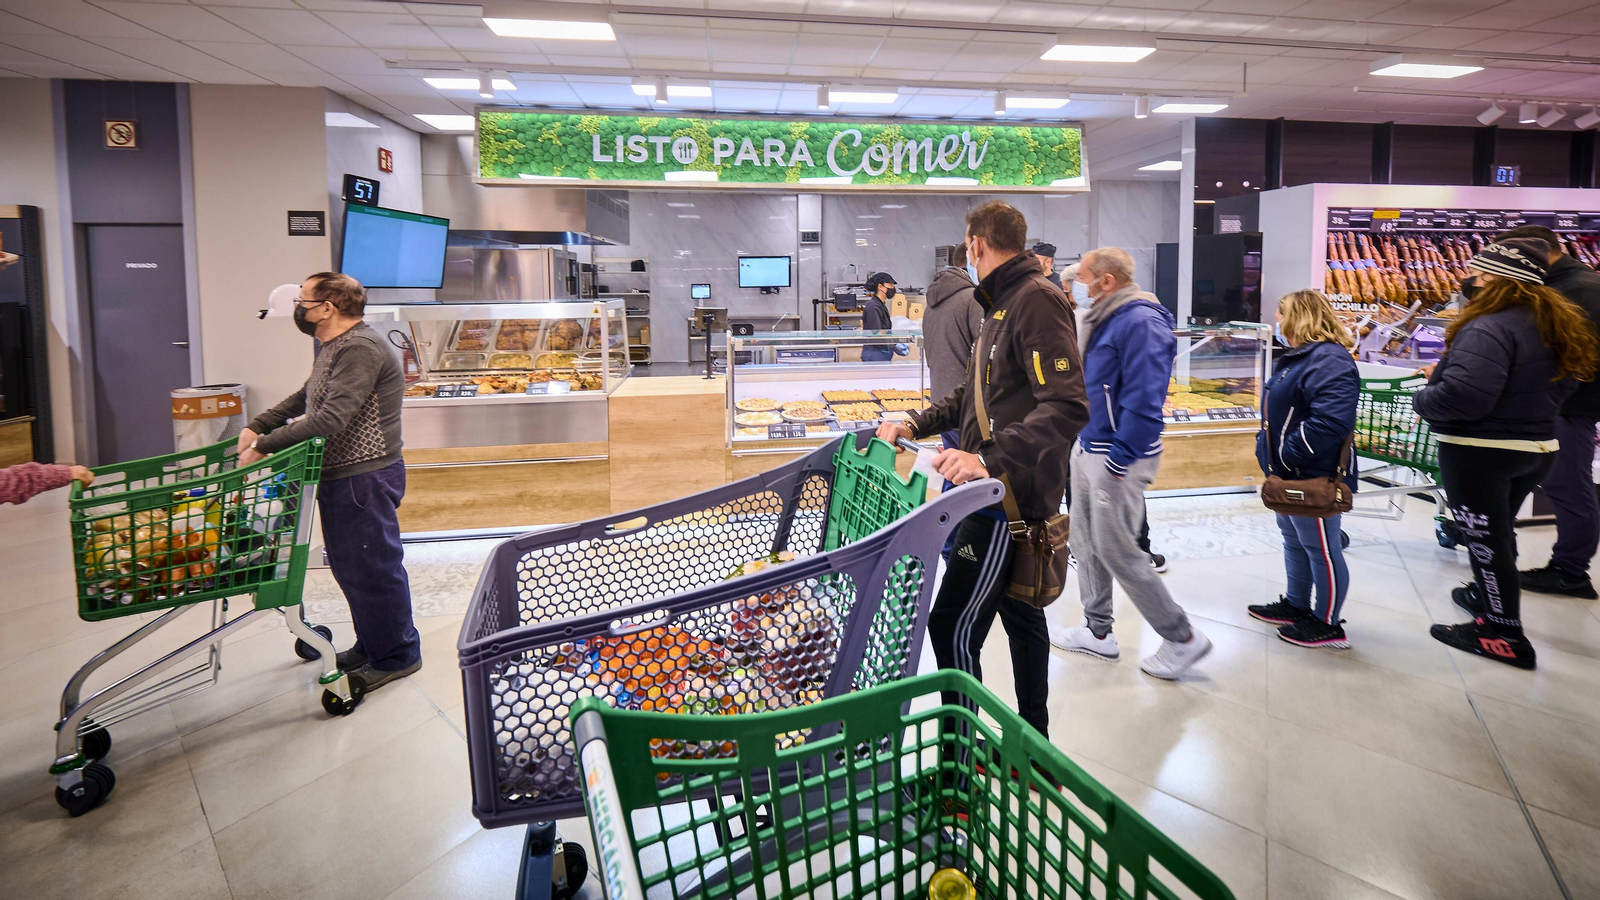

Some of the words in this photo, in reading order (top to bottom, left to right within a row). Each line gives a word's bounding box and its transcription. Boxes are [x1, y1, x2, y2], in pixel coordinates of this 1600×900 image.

[593, 134, 699, 165] LISTO
[713, 137, 814, 167] PARA
[826, 129, 988, 177] Comer
[1497, 169, 1514, 182] 01
[354, 182, 373, 200] 57
[1328, 292, 1353, 302] MÓN
[1329, 302, 1379, 312] UCHILLO
[594, 789, 627, 900] MERCADO
